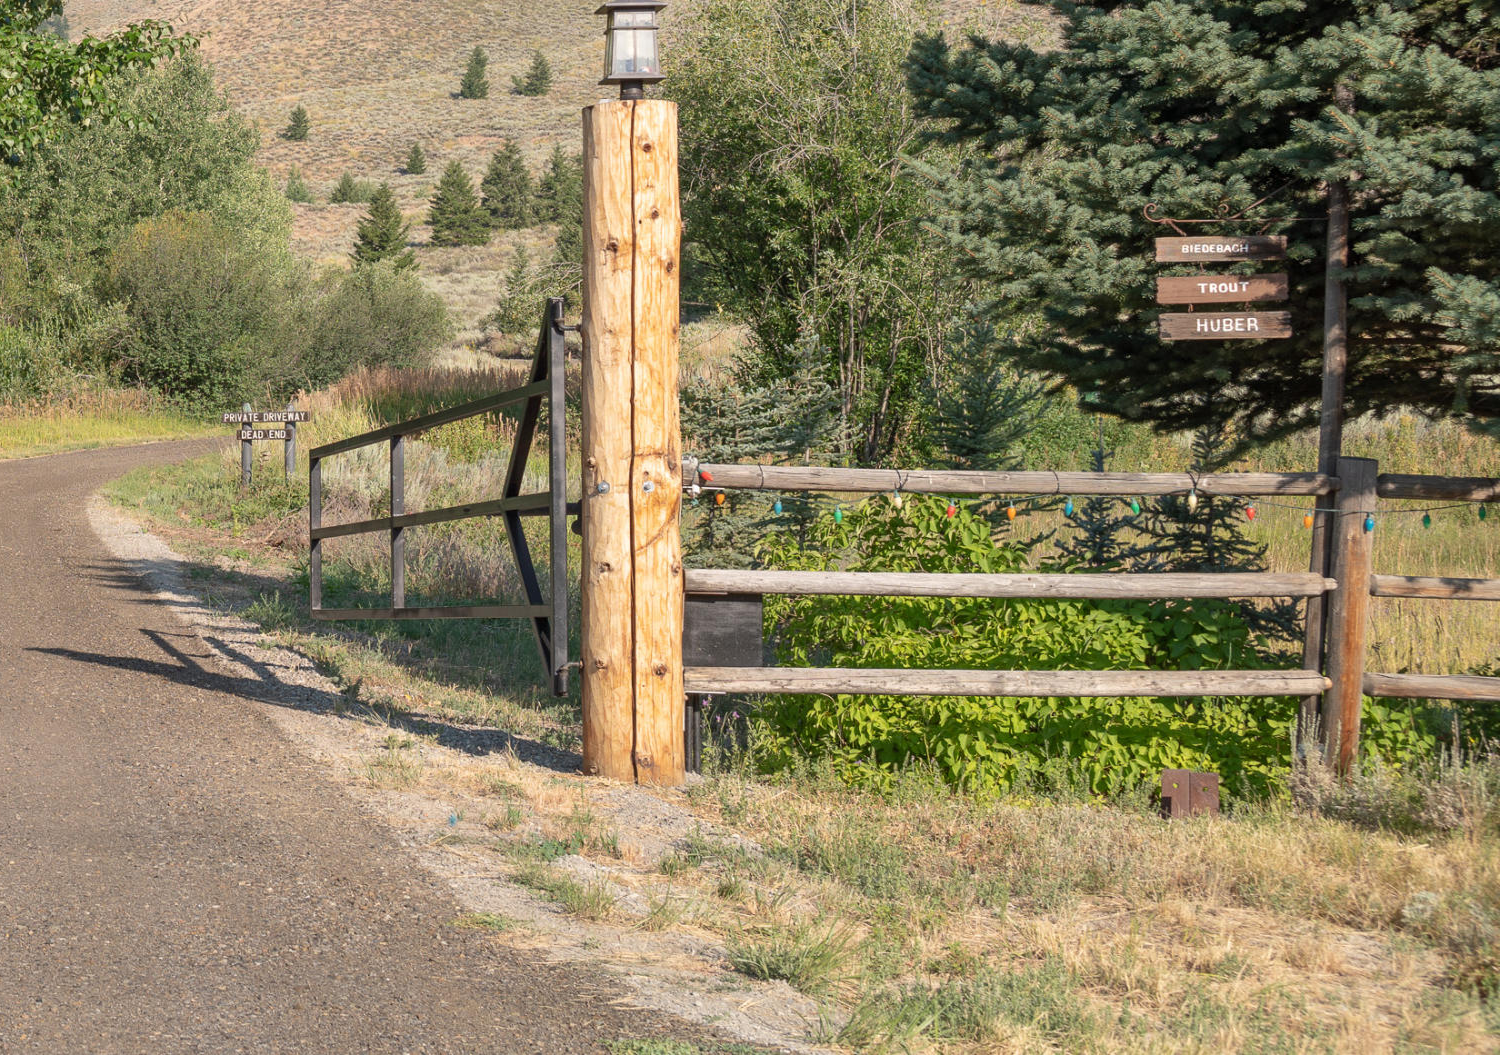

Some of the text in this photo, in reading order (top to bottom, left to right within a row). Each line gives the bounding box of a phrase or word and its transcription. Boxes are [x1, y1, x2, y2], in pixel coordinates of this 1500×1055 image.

[1181, 244, 1249, 254] BIEDEBACH
[1197, 281, 1250, 294] TROUT
[1196, 317, 1259, 332] HUBER
[224, 412, 305, 422] PRIVATE DRIVEWAY
[241, 430, 286, 440] DEAD END
